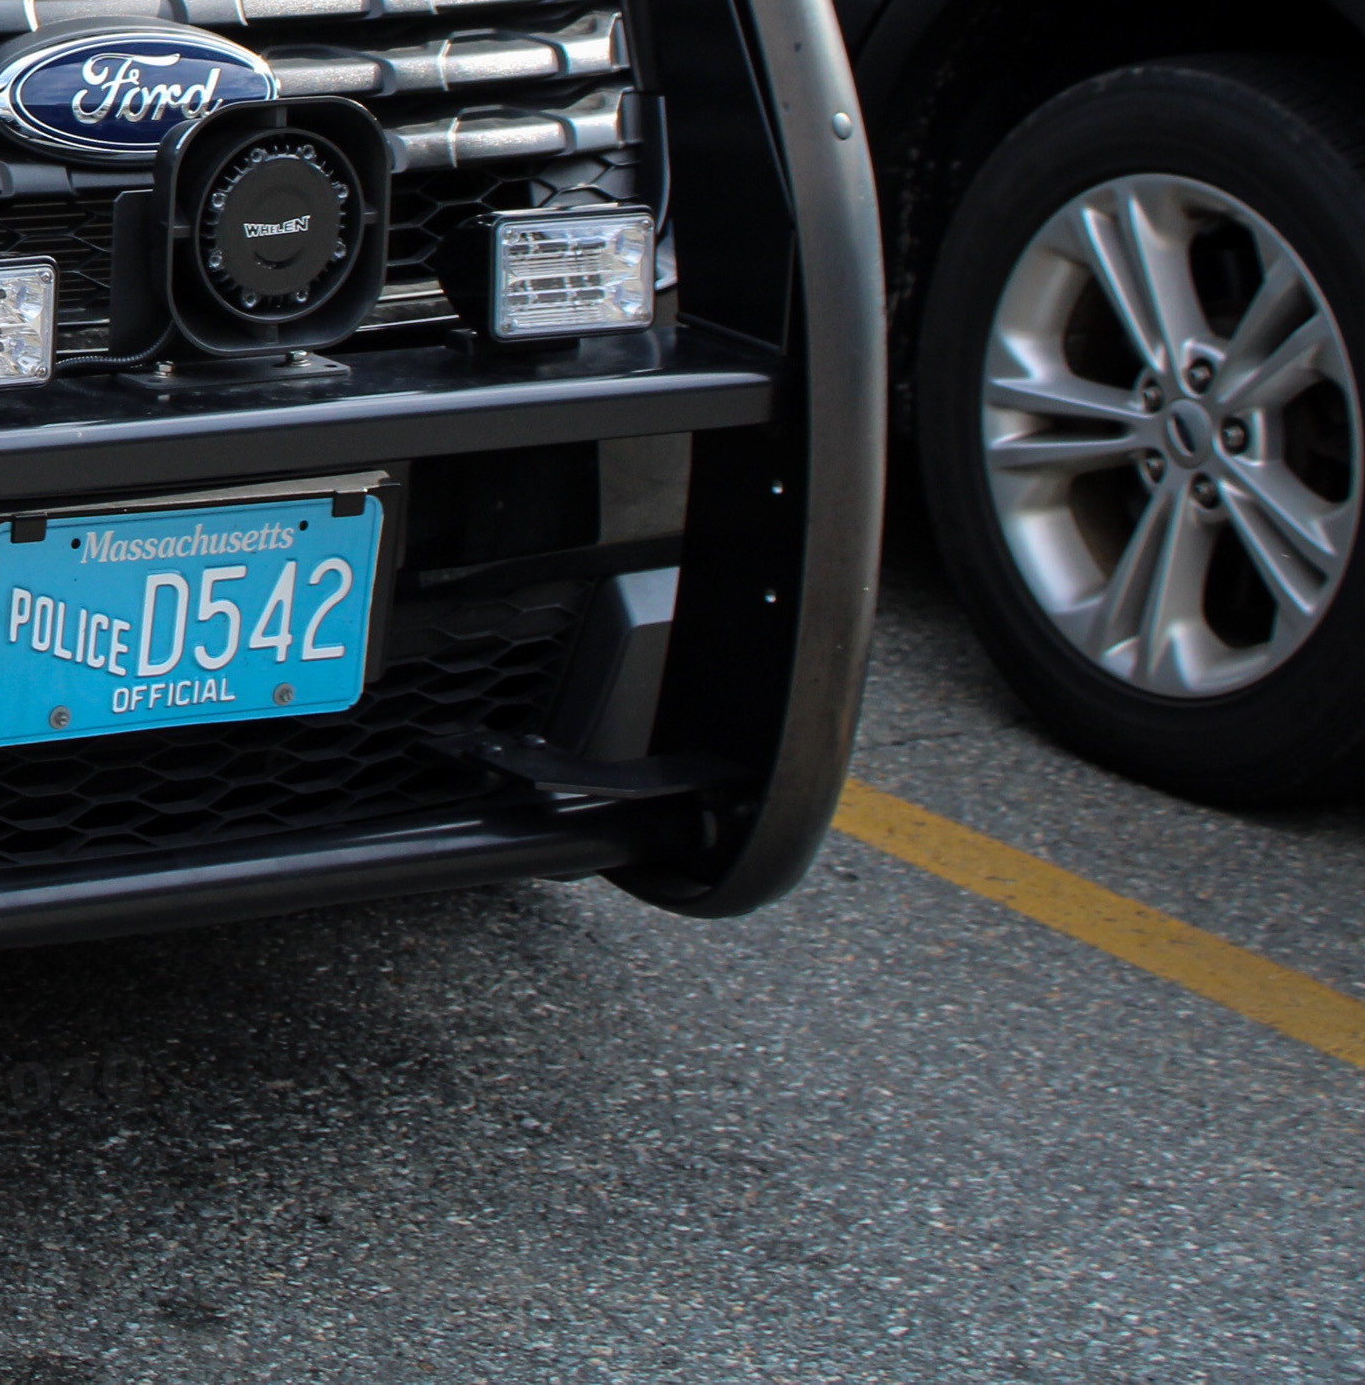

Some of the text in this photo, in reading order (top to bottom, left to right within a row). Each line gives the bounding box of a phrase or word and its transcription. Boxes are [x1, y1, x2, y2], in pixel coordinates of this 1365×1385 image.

[72, 52, 223, 124] Ford
[243, 215, 311, 239] WHELEN
[80, 522, 295, 565] Massachusetts
[9, 557, 354, 678] POLICE D542
[112, 677, 236, 714] OFFICIAL
